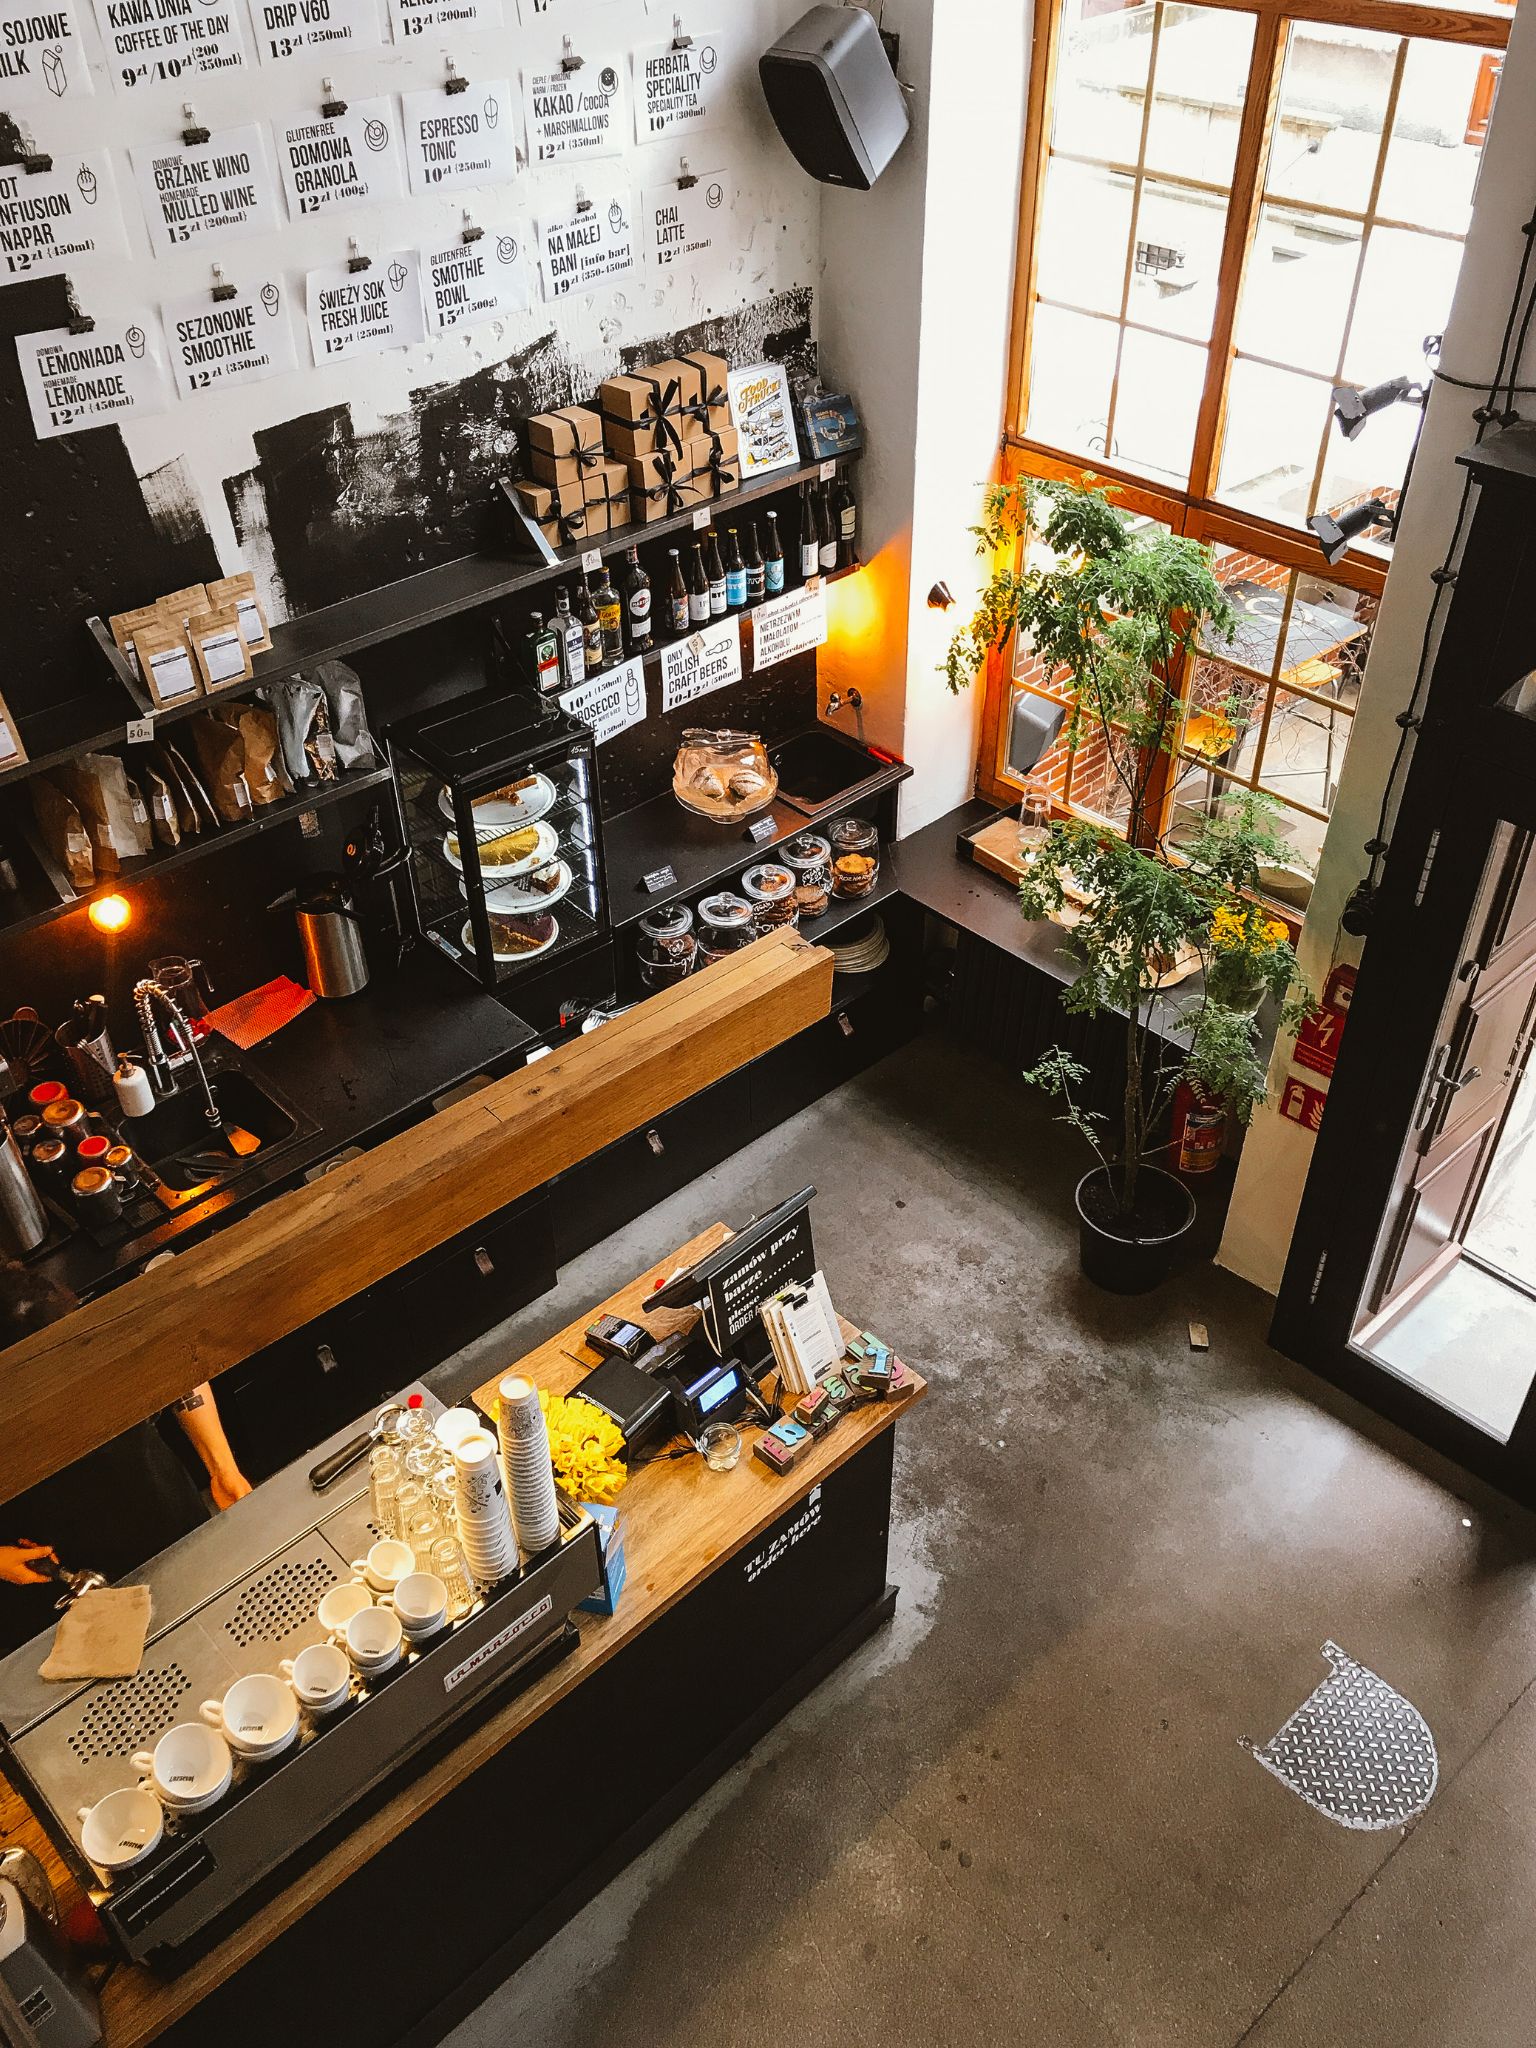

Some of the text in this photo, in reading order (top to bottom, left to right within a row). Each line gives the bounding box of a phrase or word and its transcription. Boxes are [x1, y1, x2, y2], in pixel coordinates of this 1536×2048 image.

[107, 0, 154, 28] KAWA
[263, 0, 330, 30] DRIP V60
[2, 12, 72, 46] SOJOWE
[114, 14, 230, 54] COFFEE OF THE DAY
[645, 53, 690, 78] HERBATA
[646, 71, 701, 99] SPECIALITY
[533, 93, 574, 118] KAKAO
[647, 93, 698, 114] SPECIALITY TEA
[286, 122, 336, 143] GLUTENFREE
[419, 113, 479, 141] ESPRESSO
[543, 114, 609, 138] MARSHMALLOWS
[152, 155, 184, 171] DOMOWE
[289, 137, 353, 168] DOMOWA
[420, 139, 457, 163] TONIC
[154, 153, 251, 191] GRZANE WINO
[294, 160, 359, 194] GRANOLA
[0, 193, 72, 225] NFIUSION
[159, 186, 200, 204] HOMEMADE
[162, 185, 258, 224] MULLED WINE
[570, 212, 597, 227] alcohol
[655, 205, 678, 227] CHAI
[548, 224, 601, 256] NA MAŁEJ
[656, 223, 685, 245] LATTE
[430, 245, 472, 265] GLUTENFREE
[551, 253, 577, 277] BANI
[432, 257, 485, 288] SMOTHIE
[319, 280, 386, 311] ŚWIEŻY SOK
[435, 284, 471, 310] BOWL
[176, 305, 256, 343] SEZONOWE
[321, 301, 390, 332] FRESH JUICE
[36, 345, 64, 357] DOMOWA
[37, 343, 125, 377] LEMONIADA
[182, 331, 256, 367] SMOOTHIE
[43, 375, 77, 389] HOMEMADE
[45, 375, 126, 408] LEMONADE
[667, 648, 683, 664] ONLY
[668, 655, 699, 679] POLISH
[669, 656, 728, 694] CRAFT BEERS
[722, 1224, 800, 1290] zamów przy
[724, 1270, 763, 1304] barze
[728, 1295, 760, 1326] please
[729, 1309, 754, 1336] ORDER
[744, 1550, 765, 1573] TU
[748, 1515, 821, 1583] order here
